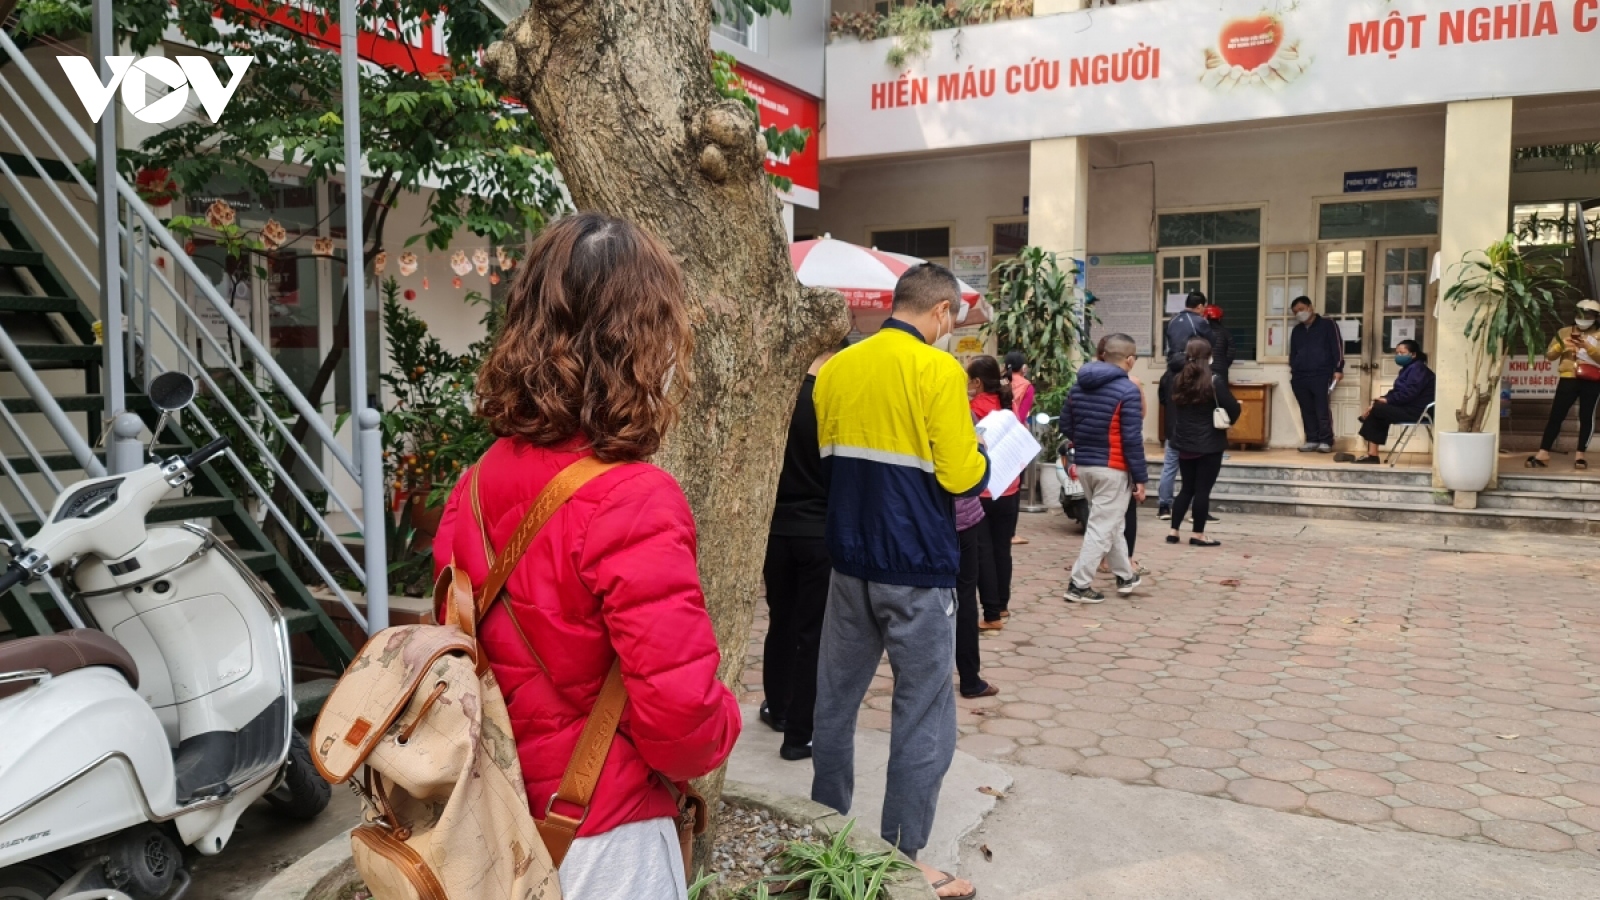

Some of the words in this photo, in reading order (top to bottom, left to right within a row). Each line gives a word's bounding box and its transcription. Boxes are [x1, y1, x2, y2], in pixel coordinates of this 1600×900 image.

[1347, 10, 1426, 60] MỘT
[871, 69, 928, 110] HIẾN
[937, 64, 996, 103] MÁU
[1005, 56, 1060, 94] CỨU
[1069, 42, 1160, 87] NGƯỜI
[1509, 362, 1529, 371] KHU
[1532, 361, 1552, 373] VỰC
